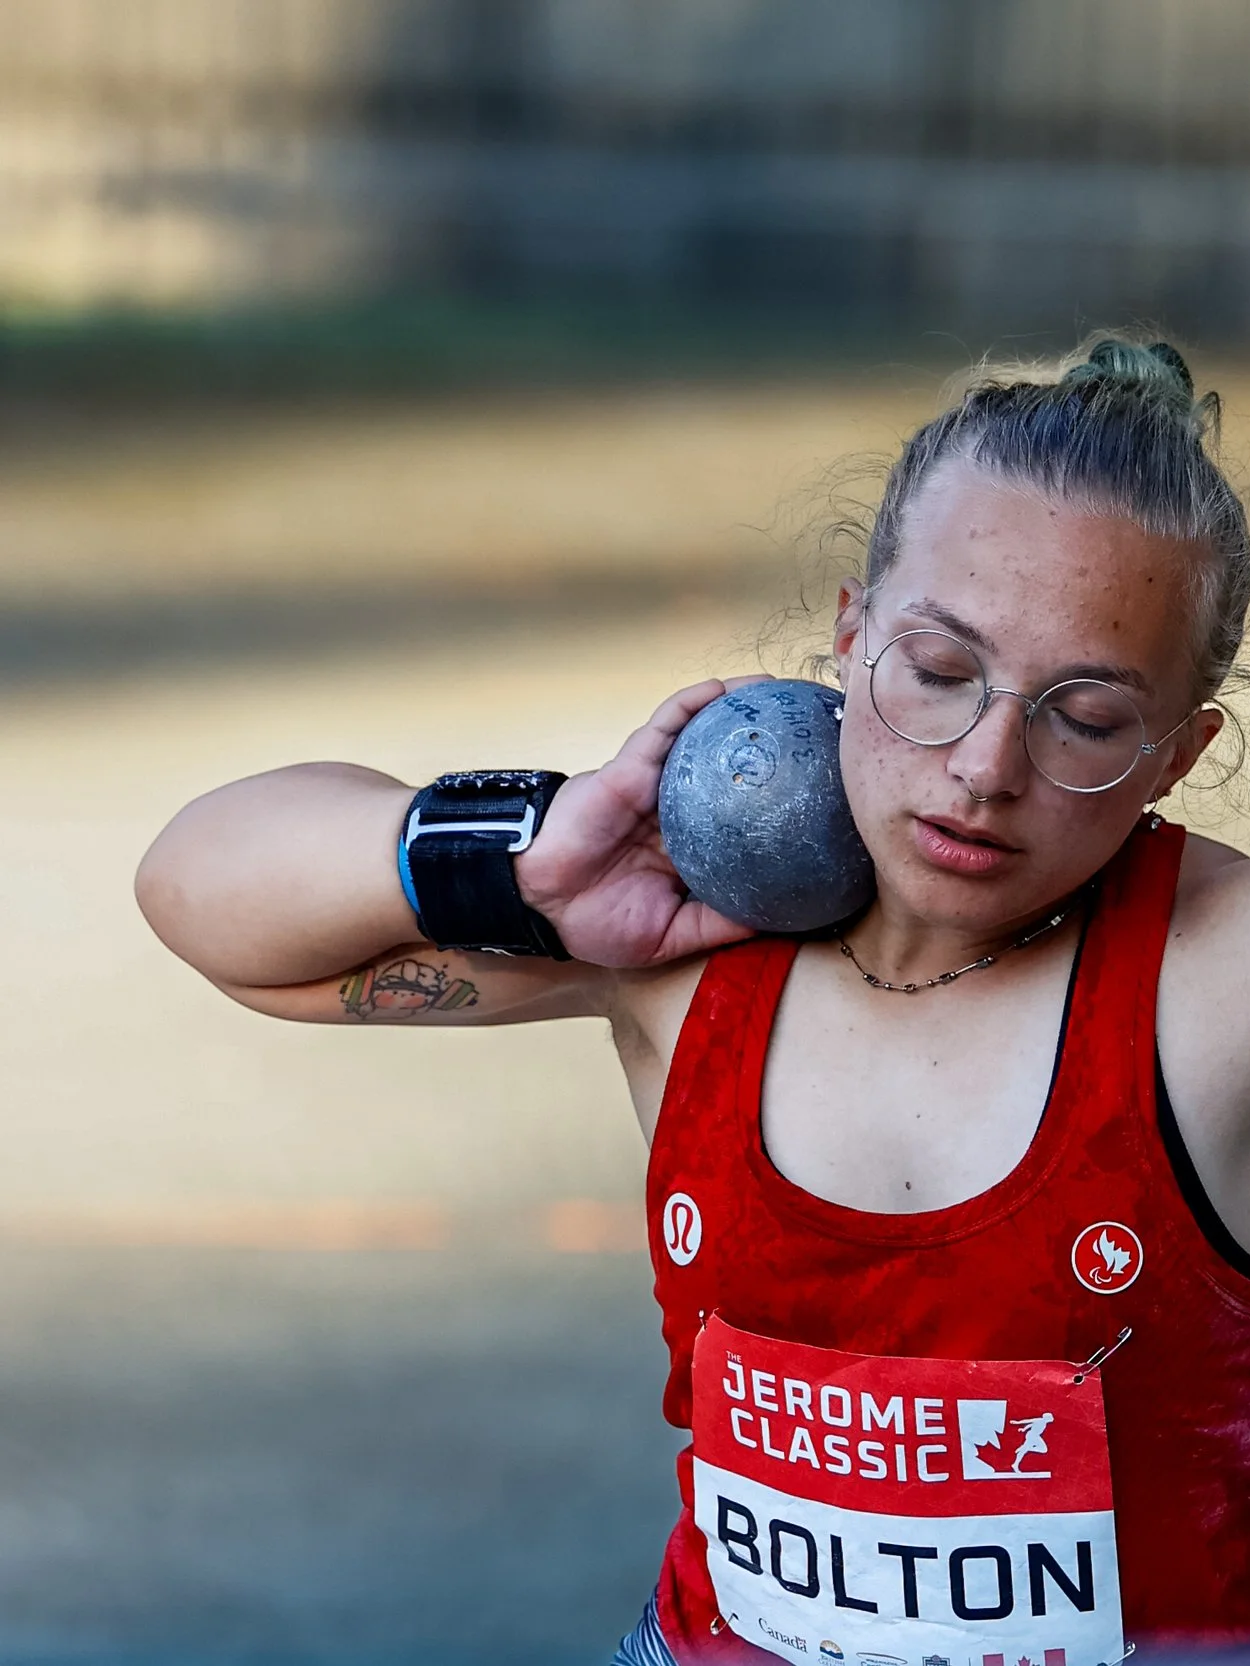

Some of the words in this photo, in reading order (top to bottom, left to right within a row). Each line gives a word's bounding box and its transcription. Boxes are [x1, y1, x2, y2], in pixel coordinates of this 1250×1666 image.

[725, 1350, 742, 1363] THE
[722, 1360, 947, 1436] JEROME
[730, 1407, 950, 1482] CLASSIC
[716, 1494, 1096, 1621] BOLTON
[758, 1617, 808, 1654] Canada
